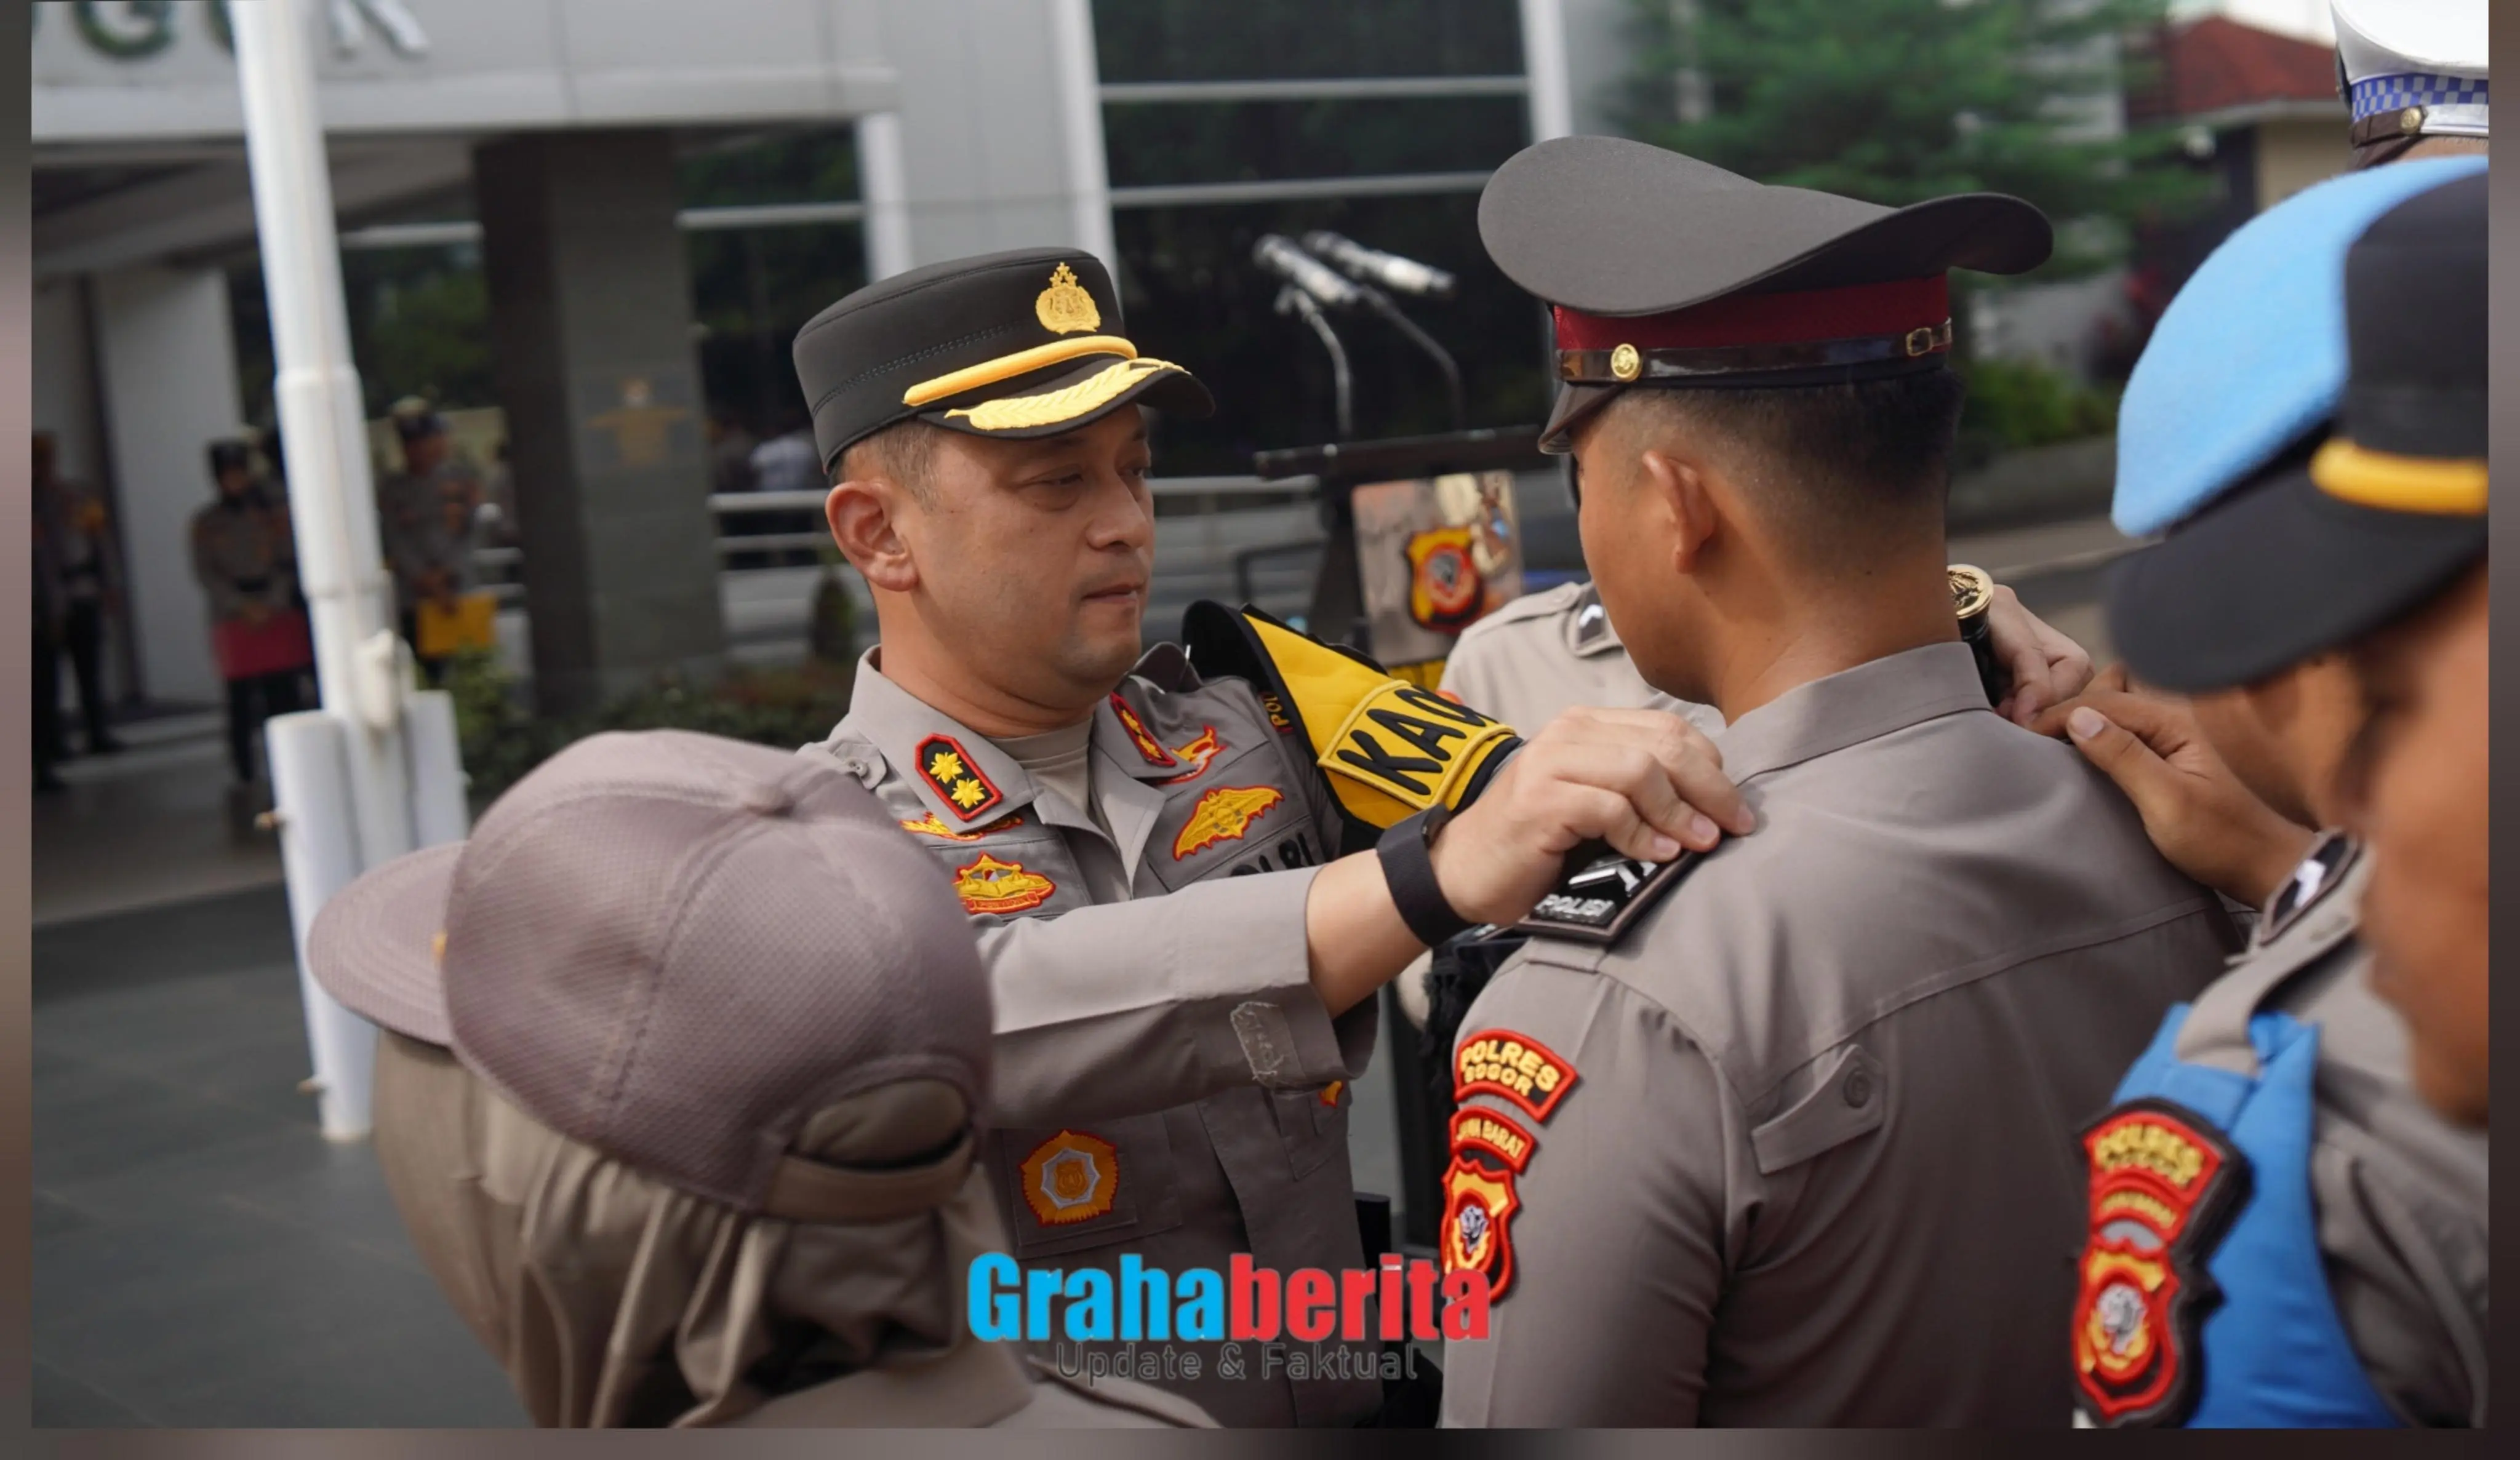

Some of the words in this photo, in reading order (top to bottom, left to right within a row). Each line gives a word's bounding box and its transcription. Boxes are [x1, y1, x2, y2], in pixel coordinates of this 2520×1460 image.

[1337, 684, 1499, 796] KAO
[1535, 894, 1617, 922] POLISI
[1460, 1040, 1561, 1092] POLRES
[1464, 1063, 1534, 1097] BOGOR
[1482, 1119, 1526, 1159] BARAT
